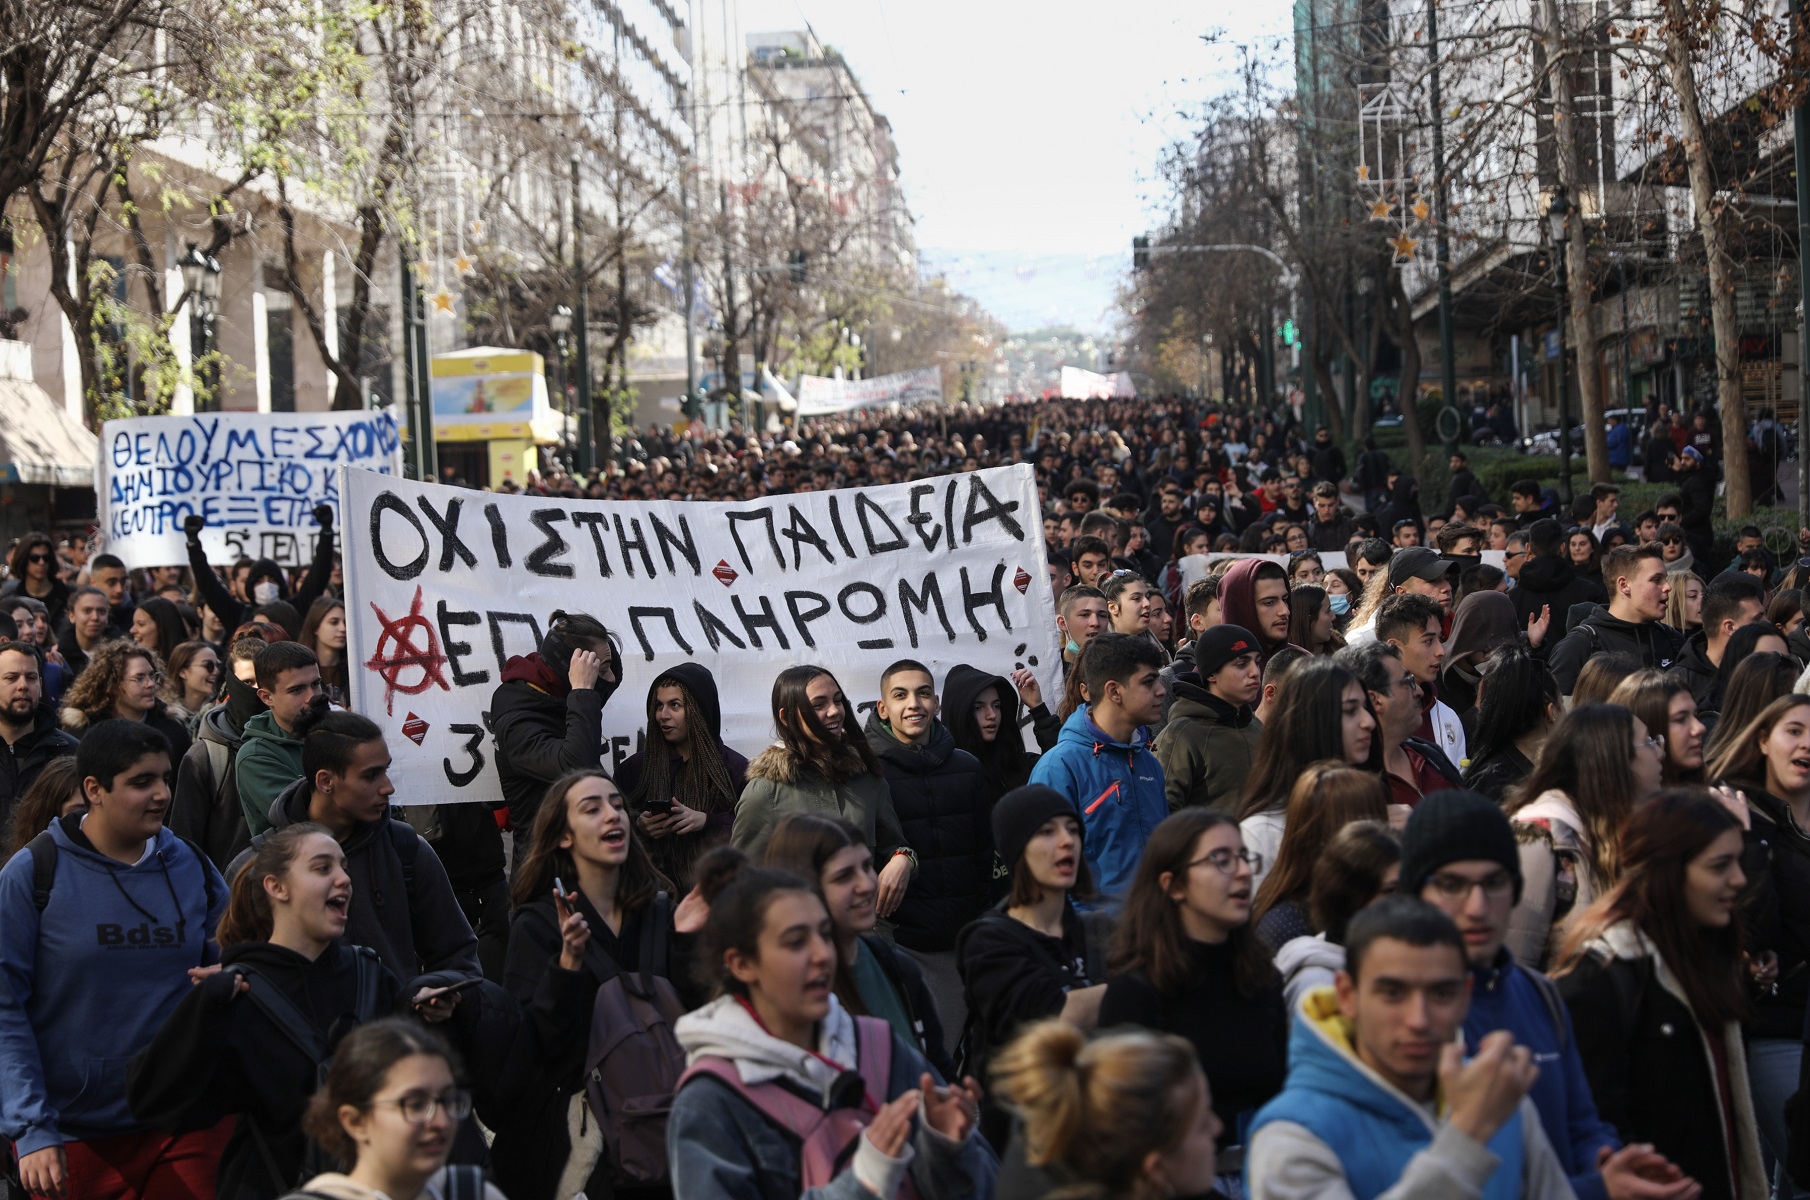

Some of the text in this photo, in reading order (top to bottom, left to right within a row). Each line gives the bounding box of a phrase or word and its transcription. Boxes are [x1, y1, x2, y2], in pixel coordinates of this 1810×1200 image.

[369, 472, 1025, 581] ΟΧΙ ΣΤΗΝ ΠΑΙΔΕΙΑ
